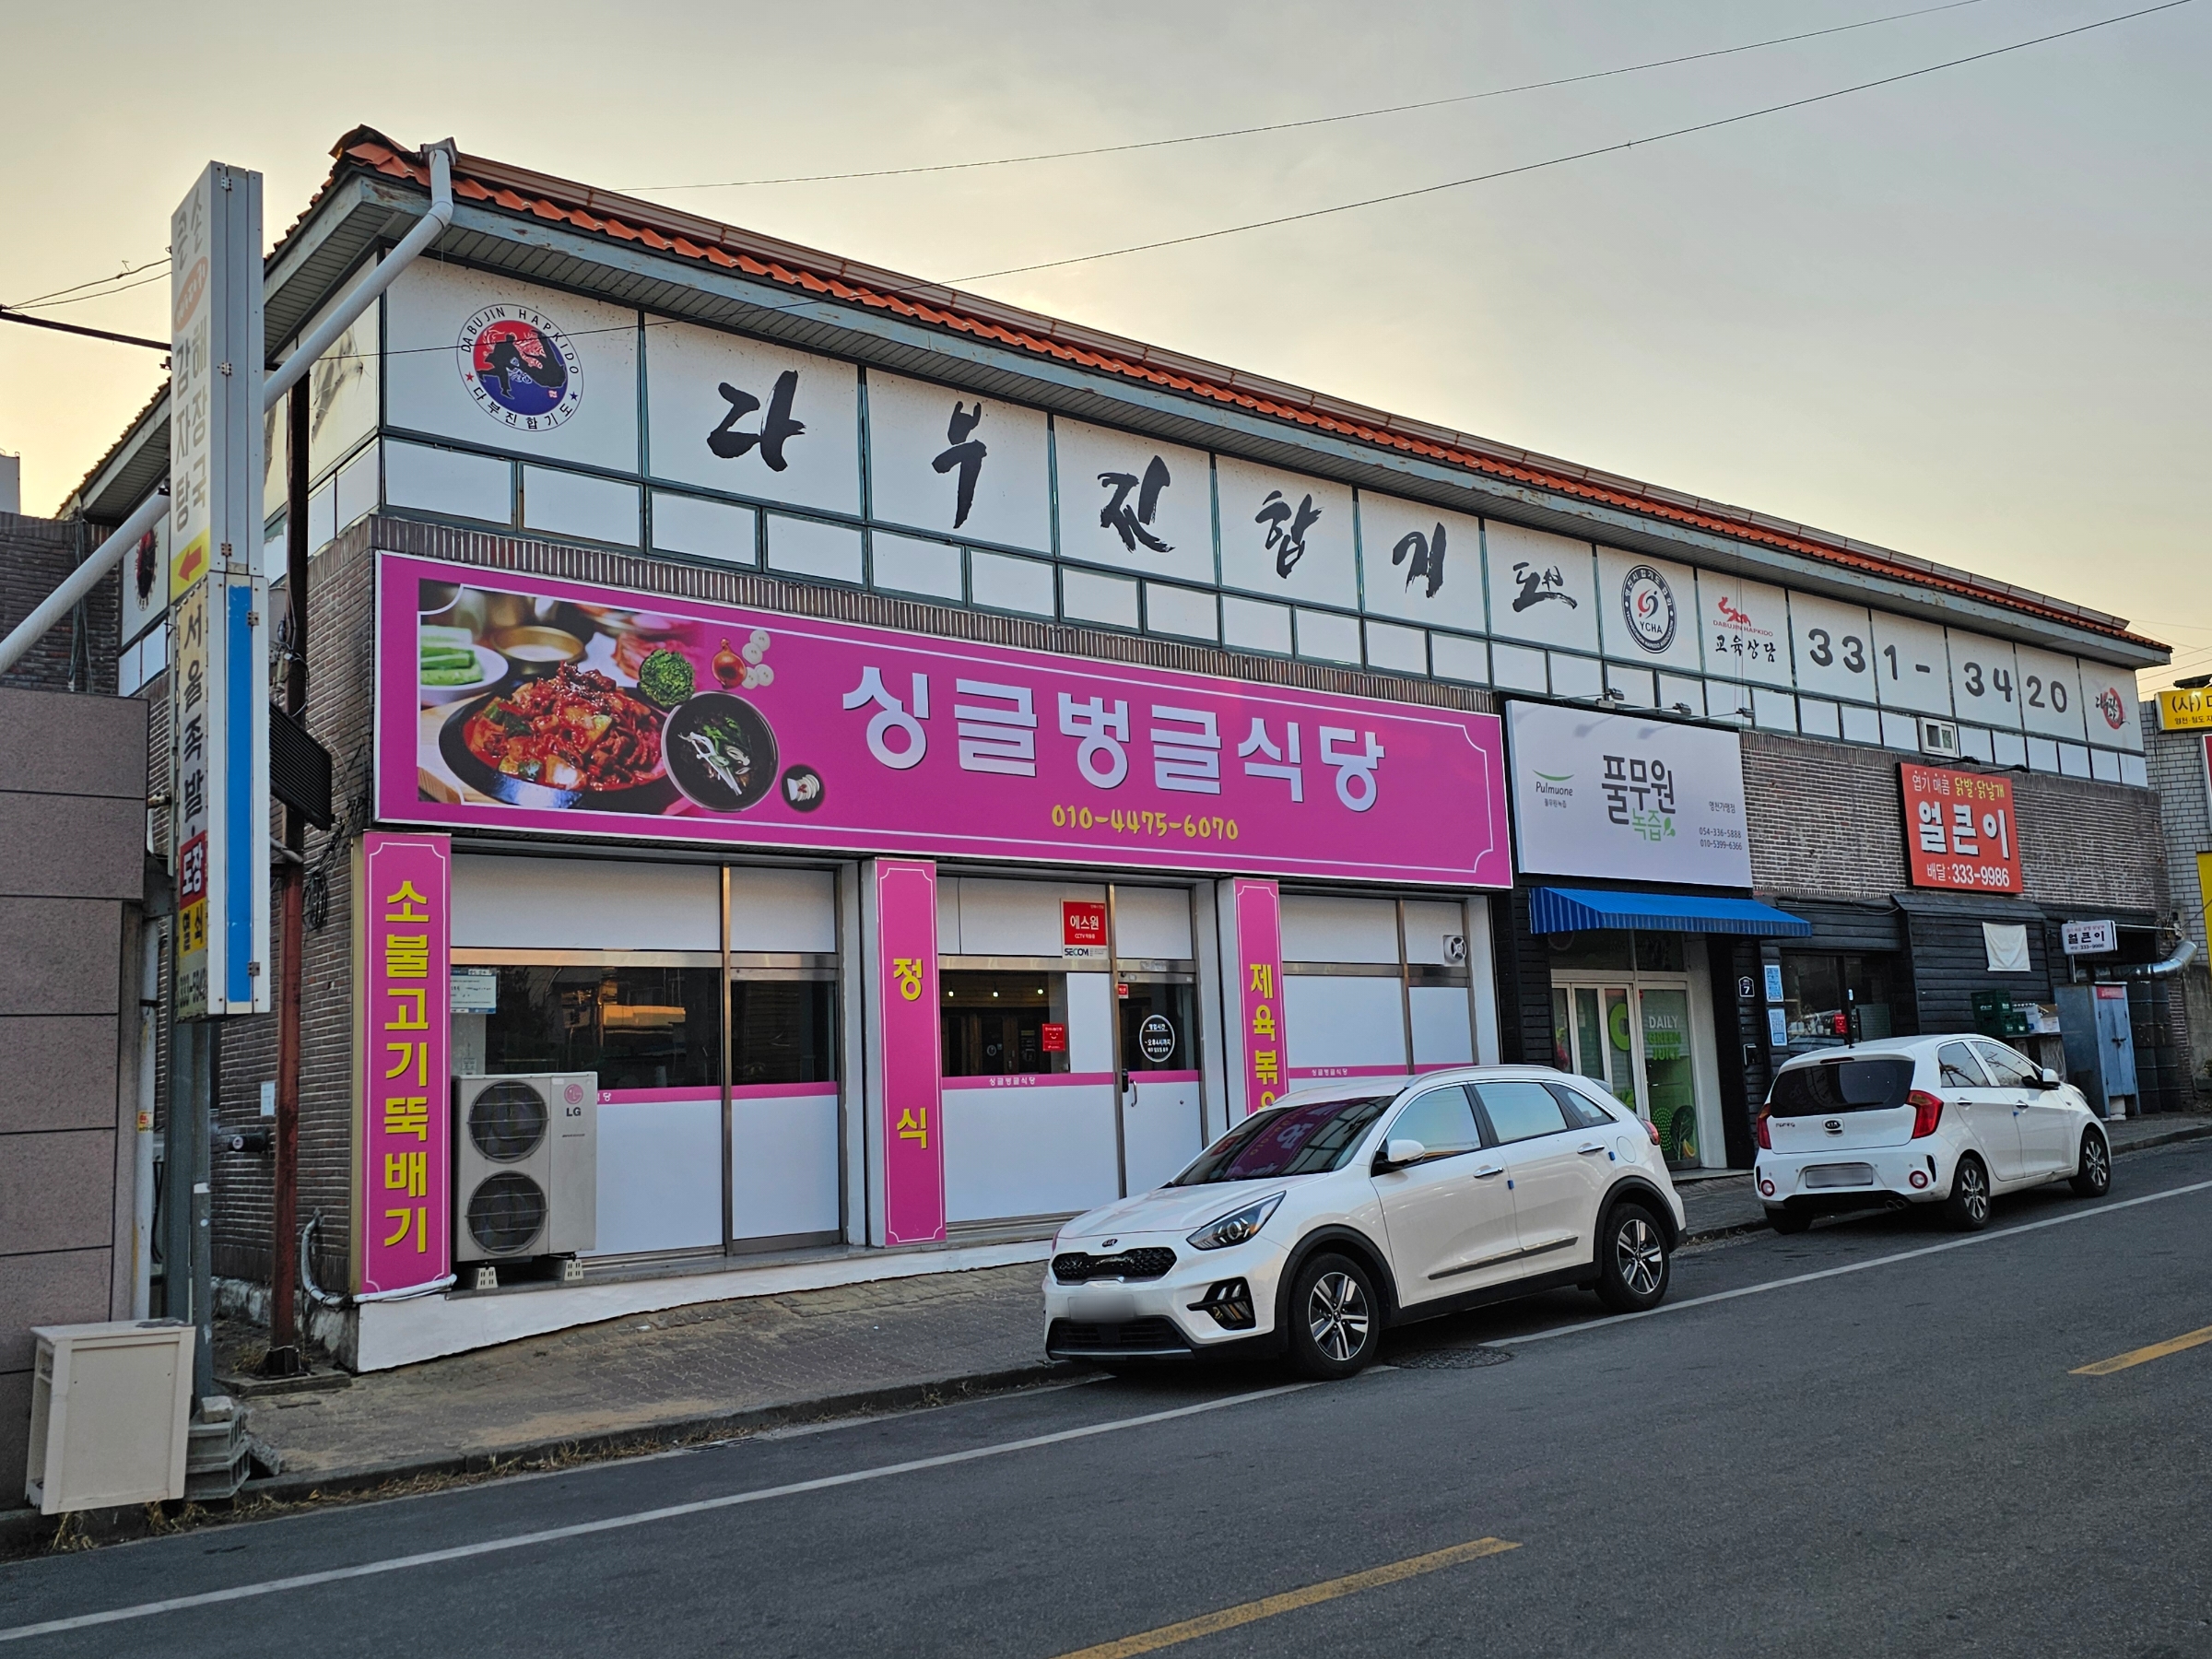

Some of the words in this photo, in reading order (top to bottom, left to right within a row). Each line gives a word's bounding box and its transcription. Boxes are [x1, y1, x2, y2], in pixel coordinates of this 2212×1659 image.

[461, 306, 506, 353] DABUJIN
[518, 309, 580, 374] HAPKIDO
[192, 314, 208, 510] 해장국
[473, 386, 573, 430] 다부진합기도
[175, 337, 191, 533] 감자탕
[1639, 620, 1664, 635] YCHA
[1712, 619, 1743, 632] DABUJIN
[1743, 626, 1773, 638] HAPKIDO
[1715, 634, 1777, 663] 교육상담
[1807, 628, 2067, 714] 331-3420
[183, 604, 204, 824] 서울족발
[2171, 694, 2201, 713] (사)
[841, 665, 1385, 814] 싱글벙글식당
[1535, 781, 1573, 796] Pulmuone
[1601, 754, 1677, 826] 풀무원
[1912, 771, 1931, 793] 엽기
[1933, 778, 1951, 796] 매콤
[1052, 804, 1240, 841] 010-4475-6070
[1631, 807, 1663, 842] 녹즙
[1918, 800, 2010, 860] 얼큰이
[1700, 839, 1743, 852] 010-5399-6366
[182, 840, 204, 895] 도장
[1069, 914, 1100, 931] 에스원
[2067, 930, 2105, 945] 얼큰이
[1064, 947, 1089, 957] SECOM
[1743, 985, 1750, 994] 7
[1648, 1015, 1678, 1030] DAILY
[1647, 1030, 1682, 1045] GREEN
[1652, 1046, 1681, 1061] JUICE
[383, 880, 429, 1254] 소불고기뚝배기
[1312, 1067, 1348, 1077] 싱글벙글식당
[988, 1076, 1036, 1087] 싱글벙글식당
[566, 1107, 582, 1117] LG
